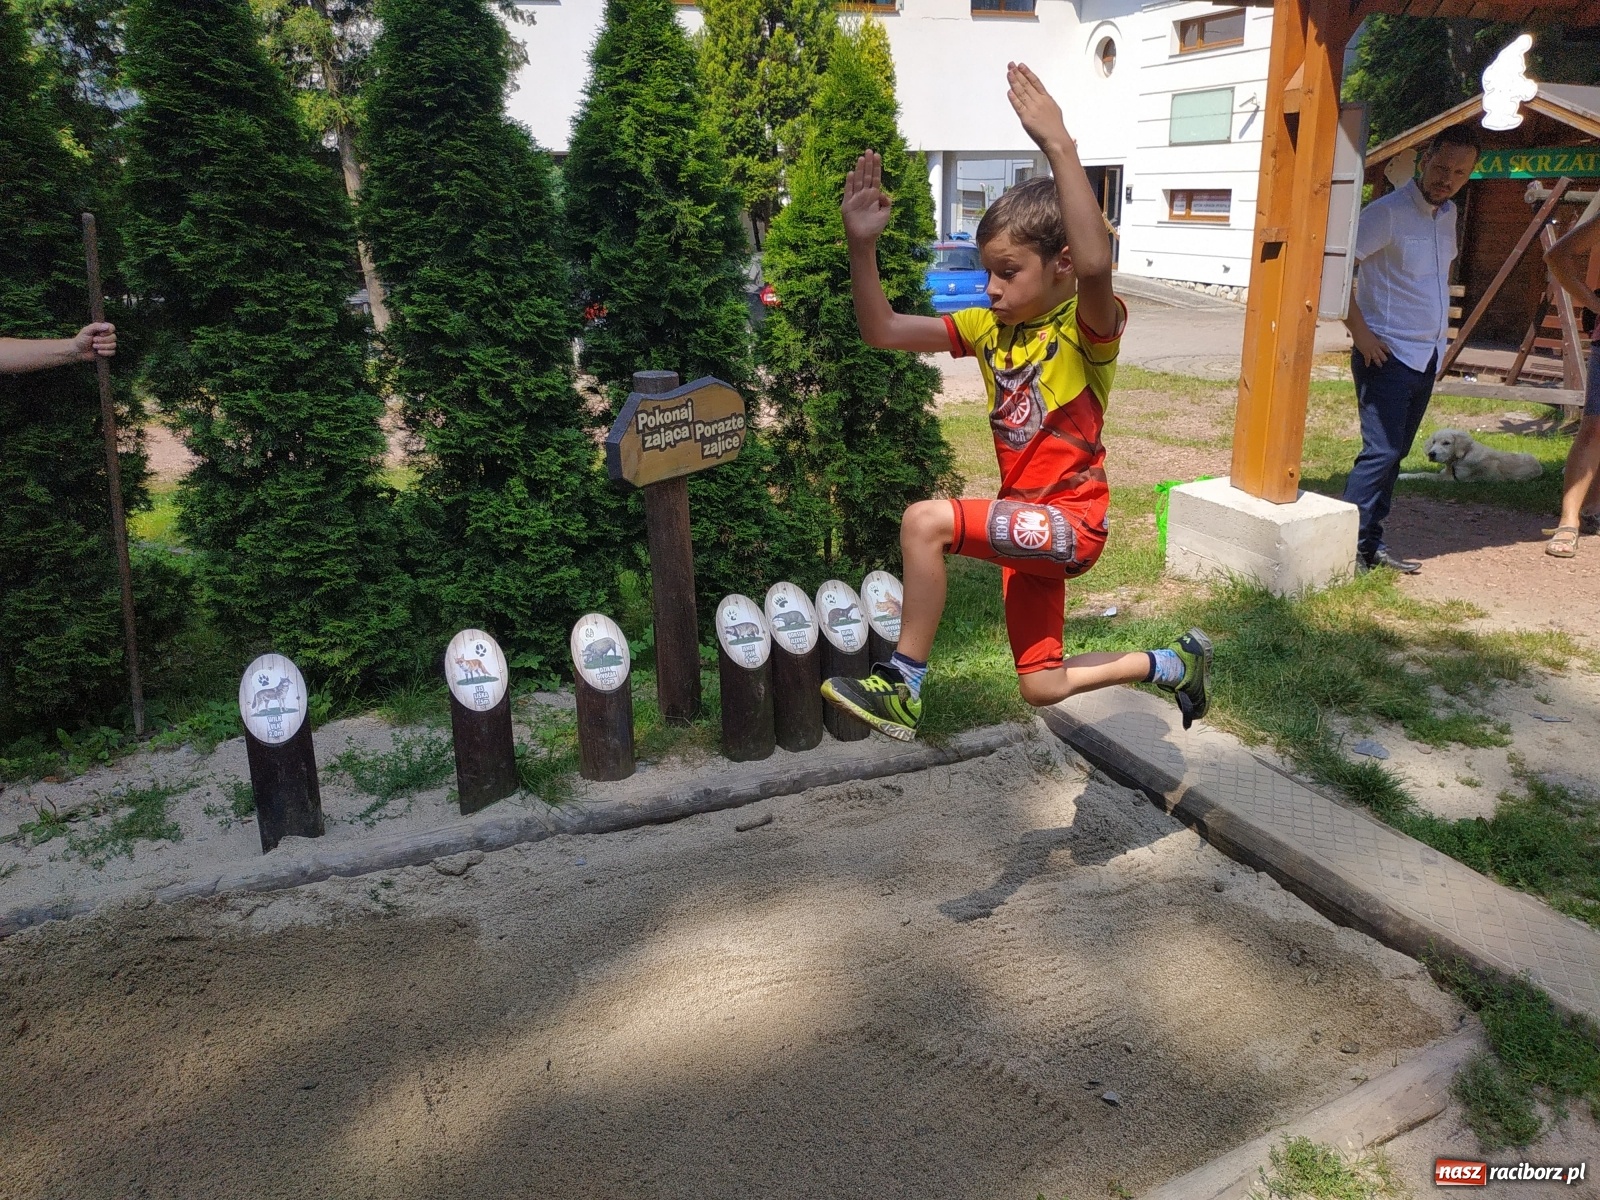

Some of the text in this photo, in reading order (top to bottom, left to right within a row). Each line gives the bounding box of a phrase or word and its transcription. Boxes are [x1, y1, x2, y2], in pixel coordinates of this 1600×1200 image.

[1509, 153, 1600, 173] SKRZAT
[637, 401, 692, 430] Pokonaj
[644, 425, 690, 449] zająca
[695, 416, 744, 439] Porazte
[703, 435, 740, 457] zajíce
[995, 515, 1008, 540] OCR
